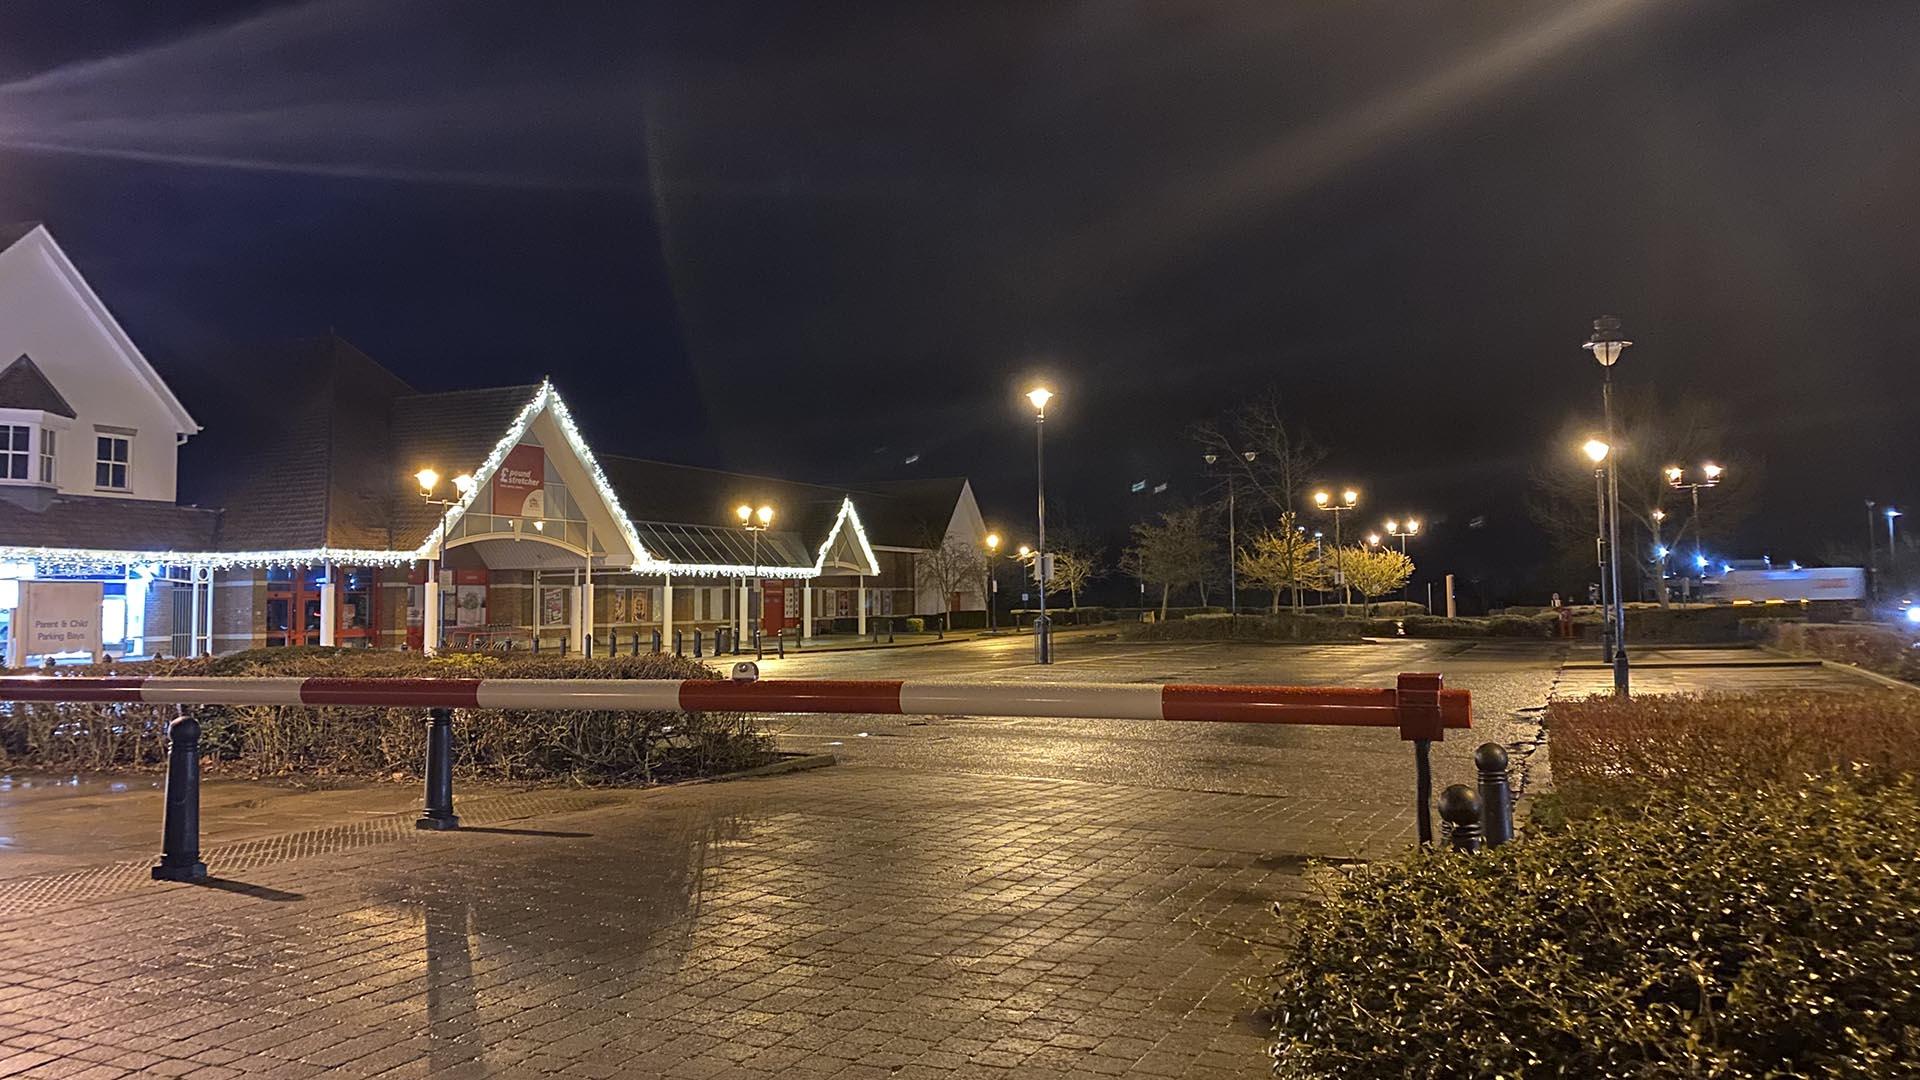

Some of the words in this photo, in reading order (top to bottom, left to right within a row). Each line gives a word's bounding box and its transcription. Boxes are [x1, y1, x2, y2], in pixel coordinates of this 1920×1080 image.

[509, 477, 539, 486] stretcher
[36, 620, 58, 628] Parent
[61, 620, 67, 628] &
[70, 620, 88, 628] Child
[38, 632, 65, 641] Parking
[67, 632, 85, 640] Bays
